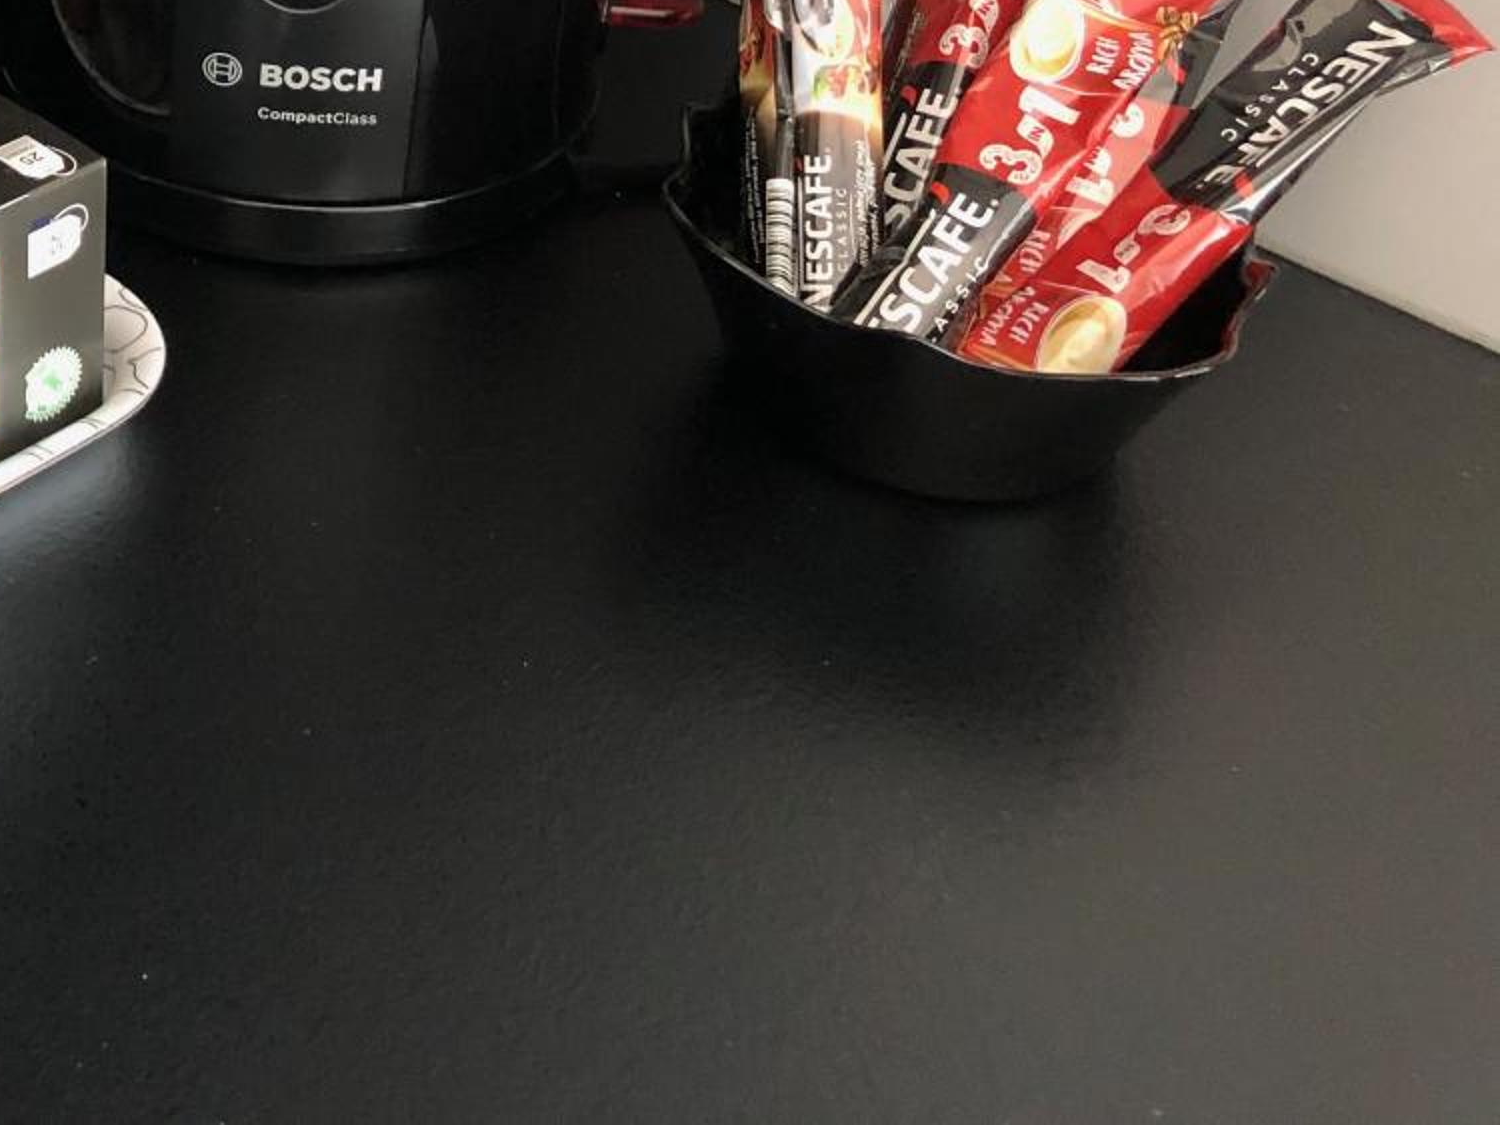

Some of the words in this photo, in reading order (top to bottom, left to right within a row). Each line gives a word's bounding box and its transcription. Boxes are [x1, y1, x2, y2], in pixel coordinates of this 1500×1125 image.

[259, 62, 383, 92] BOSCH
[1221, 52, 1319, 142] CLASSIC
[257, 106, 378, 125] CompactClass
[19, 151, 45, 166] 25
